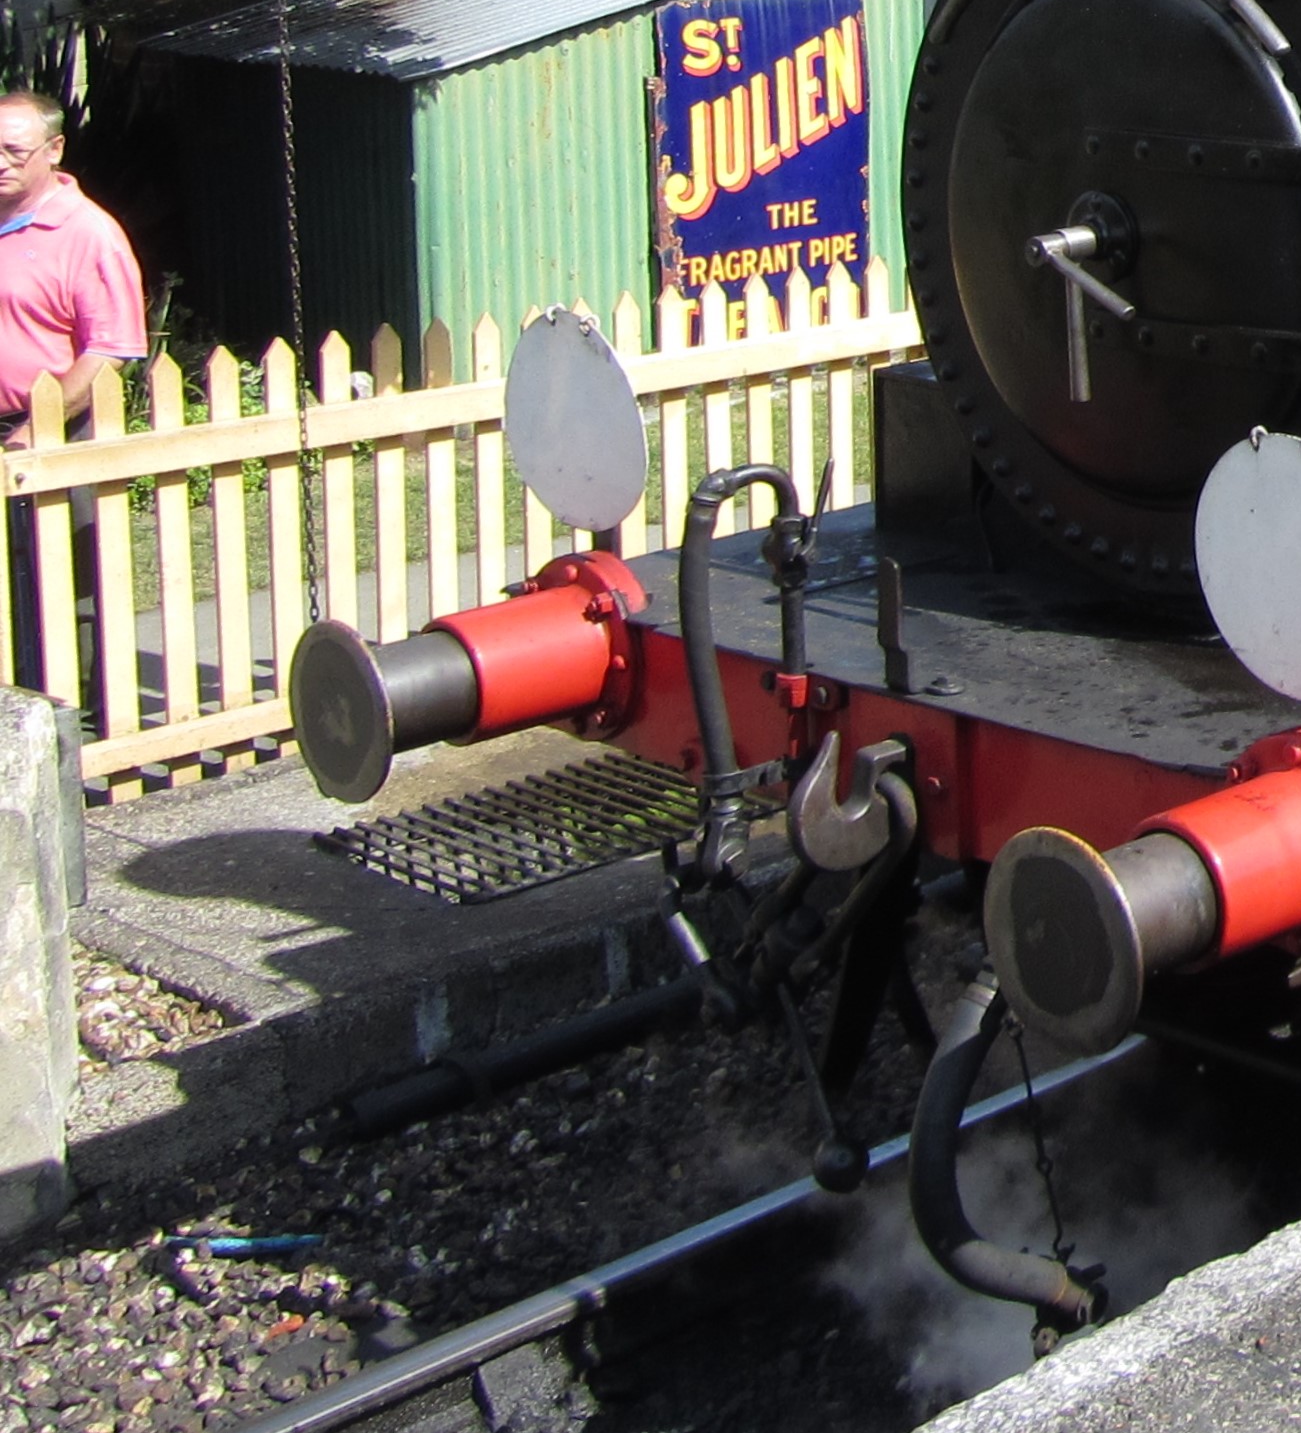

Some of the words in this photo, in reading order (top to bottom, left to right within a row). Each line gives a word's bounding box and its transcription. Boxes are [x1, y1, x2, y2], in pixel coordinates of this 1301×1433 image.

[664, 16, 863, 220] JULIEN
[766, 199, 818, 230] THE
[808, 233, 858, 268] PIPE
